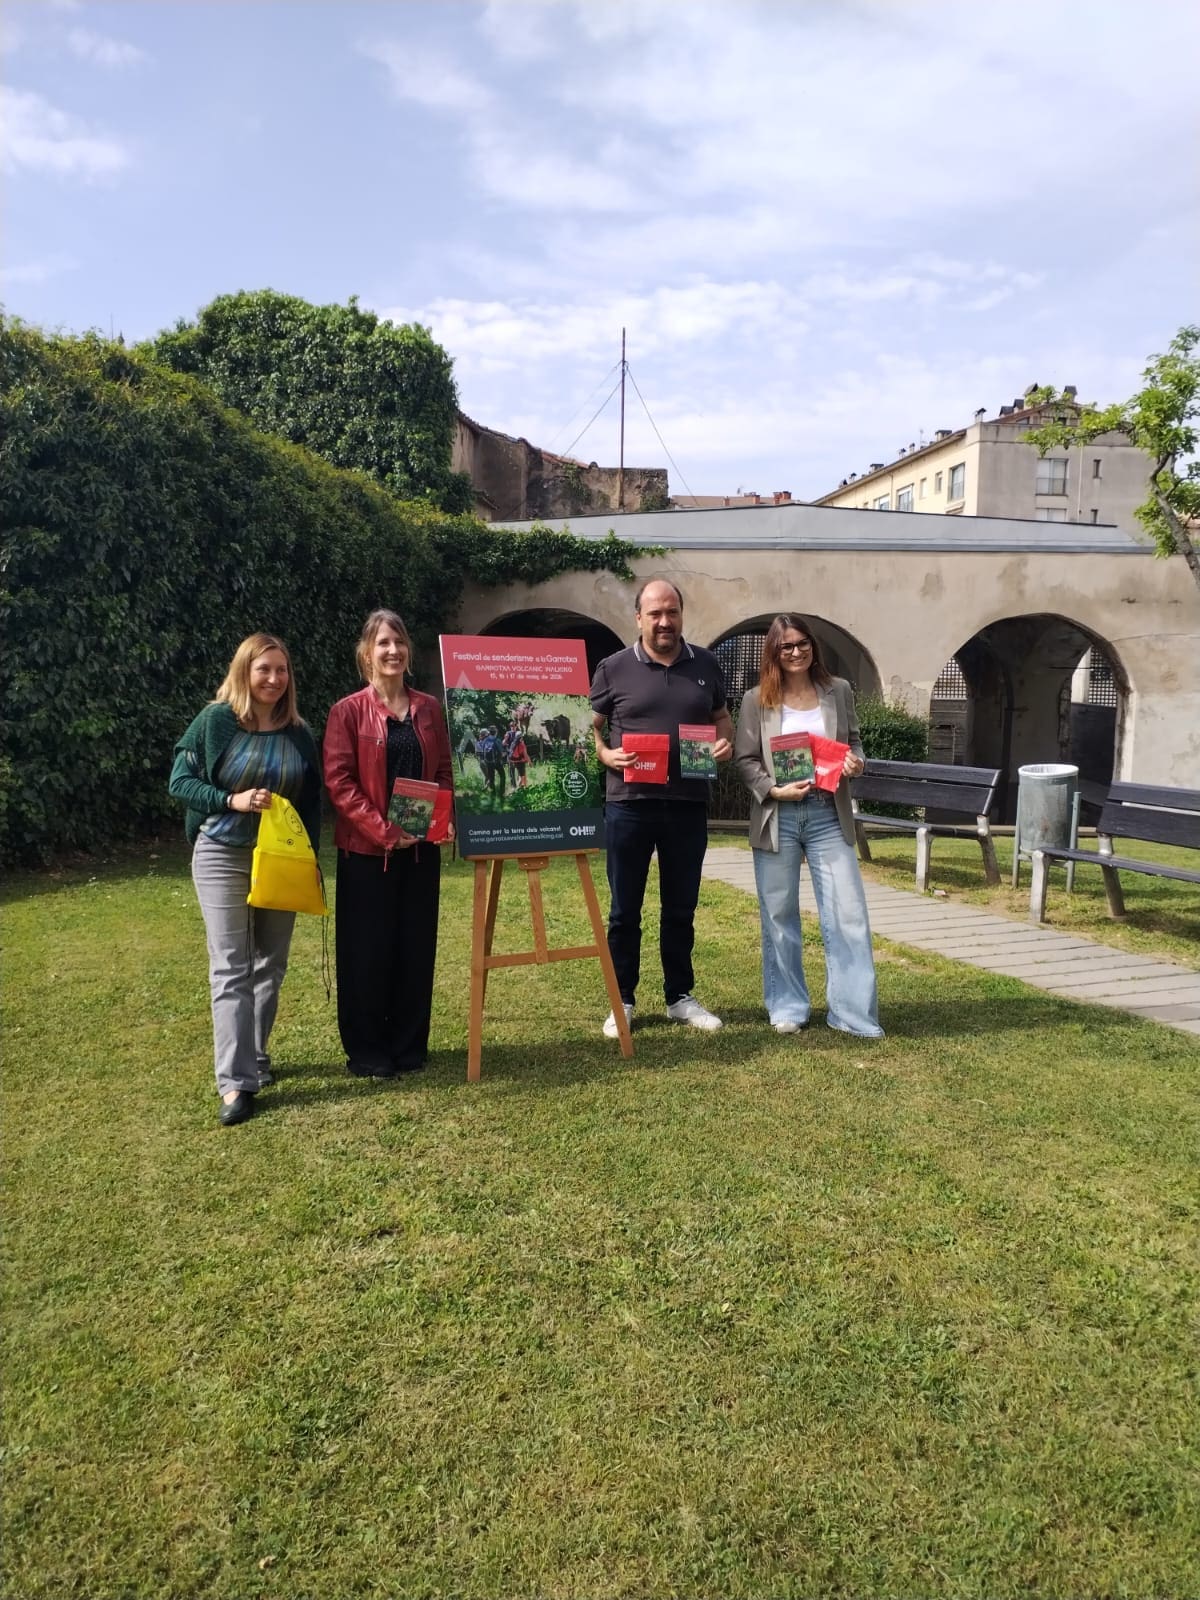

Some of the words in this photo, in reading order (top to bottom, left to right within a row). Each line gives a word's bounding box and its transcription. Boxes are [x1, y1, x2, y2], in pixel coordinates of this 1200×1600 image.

[452, 651, 482, 661] Festival
[483, 653, 491, 661] de
[491, 652, 534, 662] senderisme
[546, 654, 578, 663] Garrotxa
